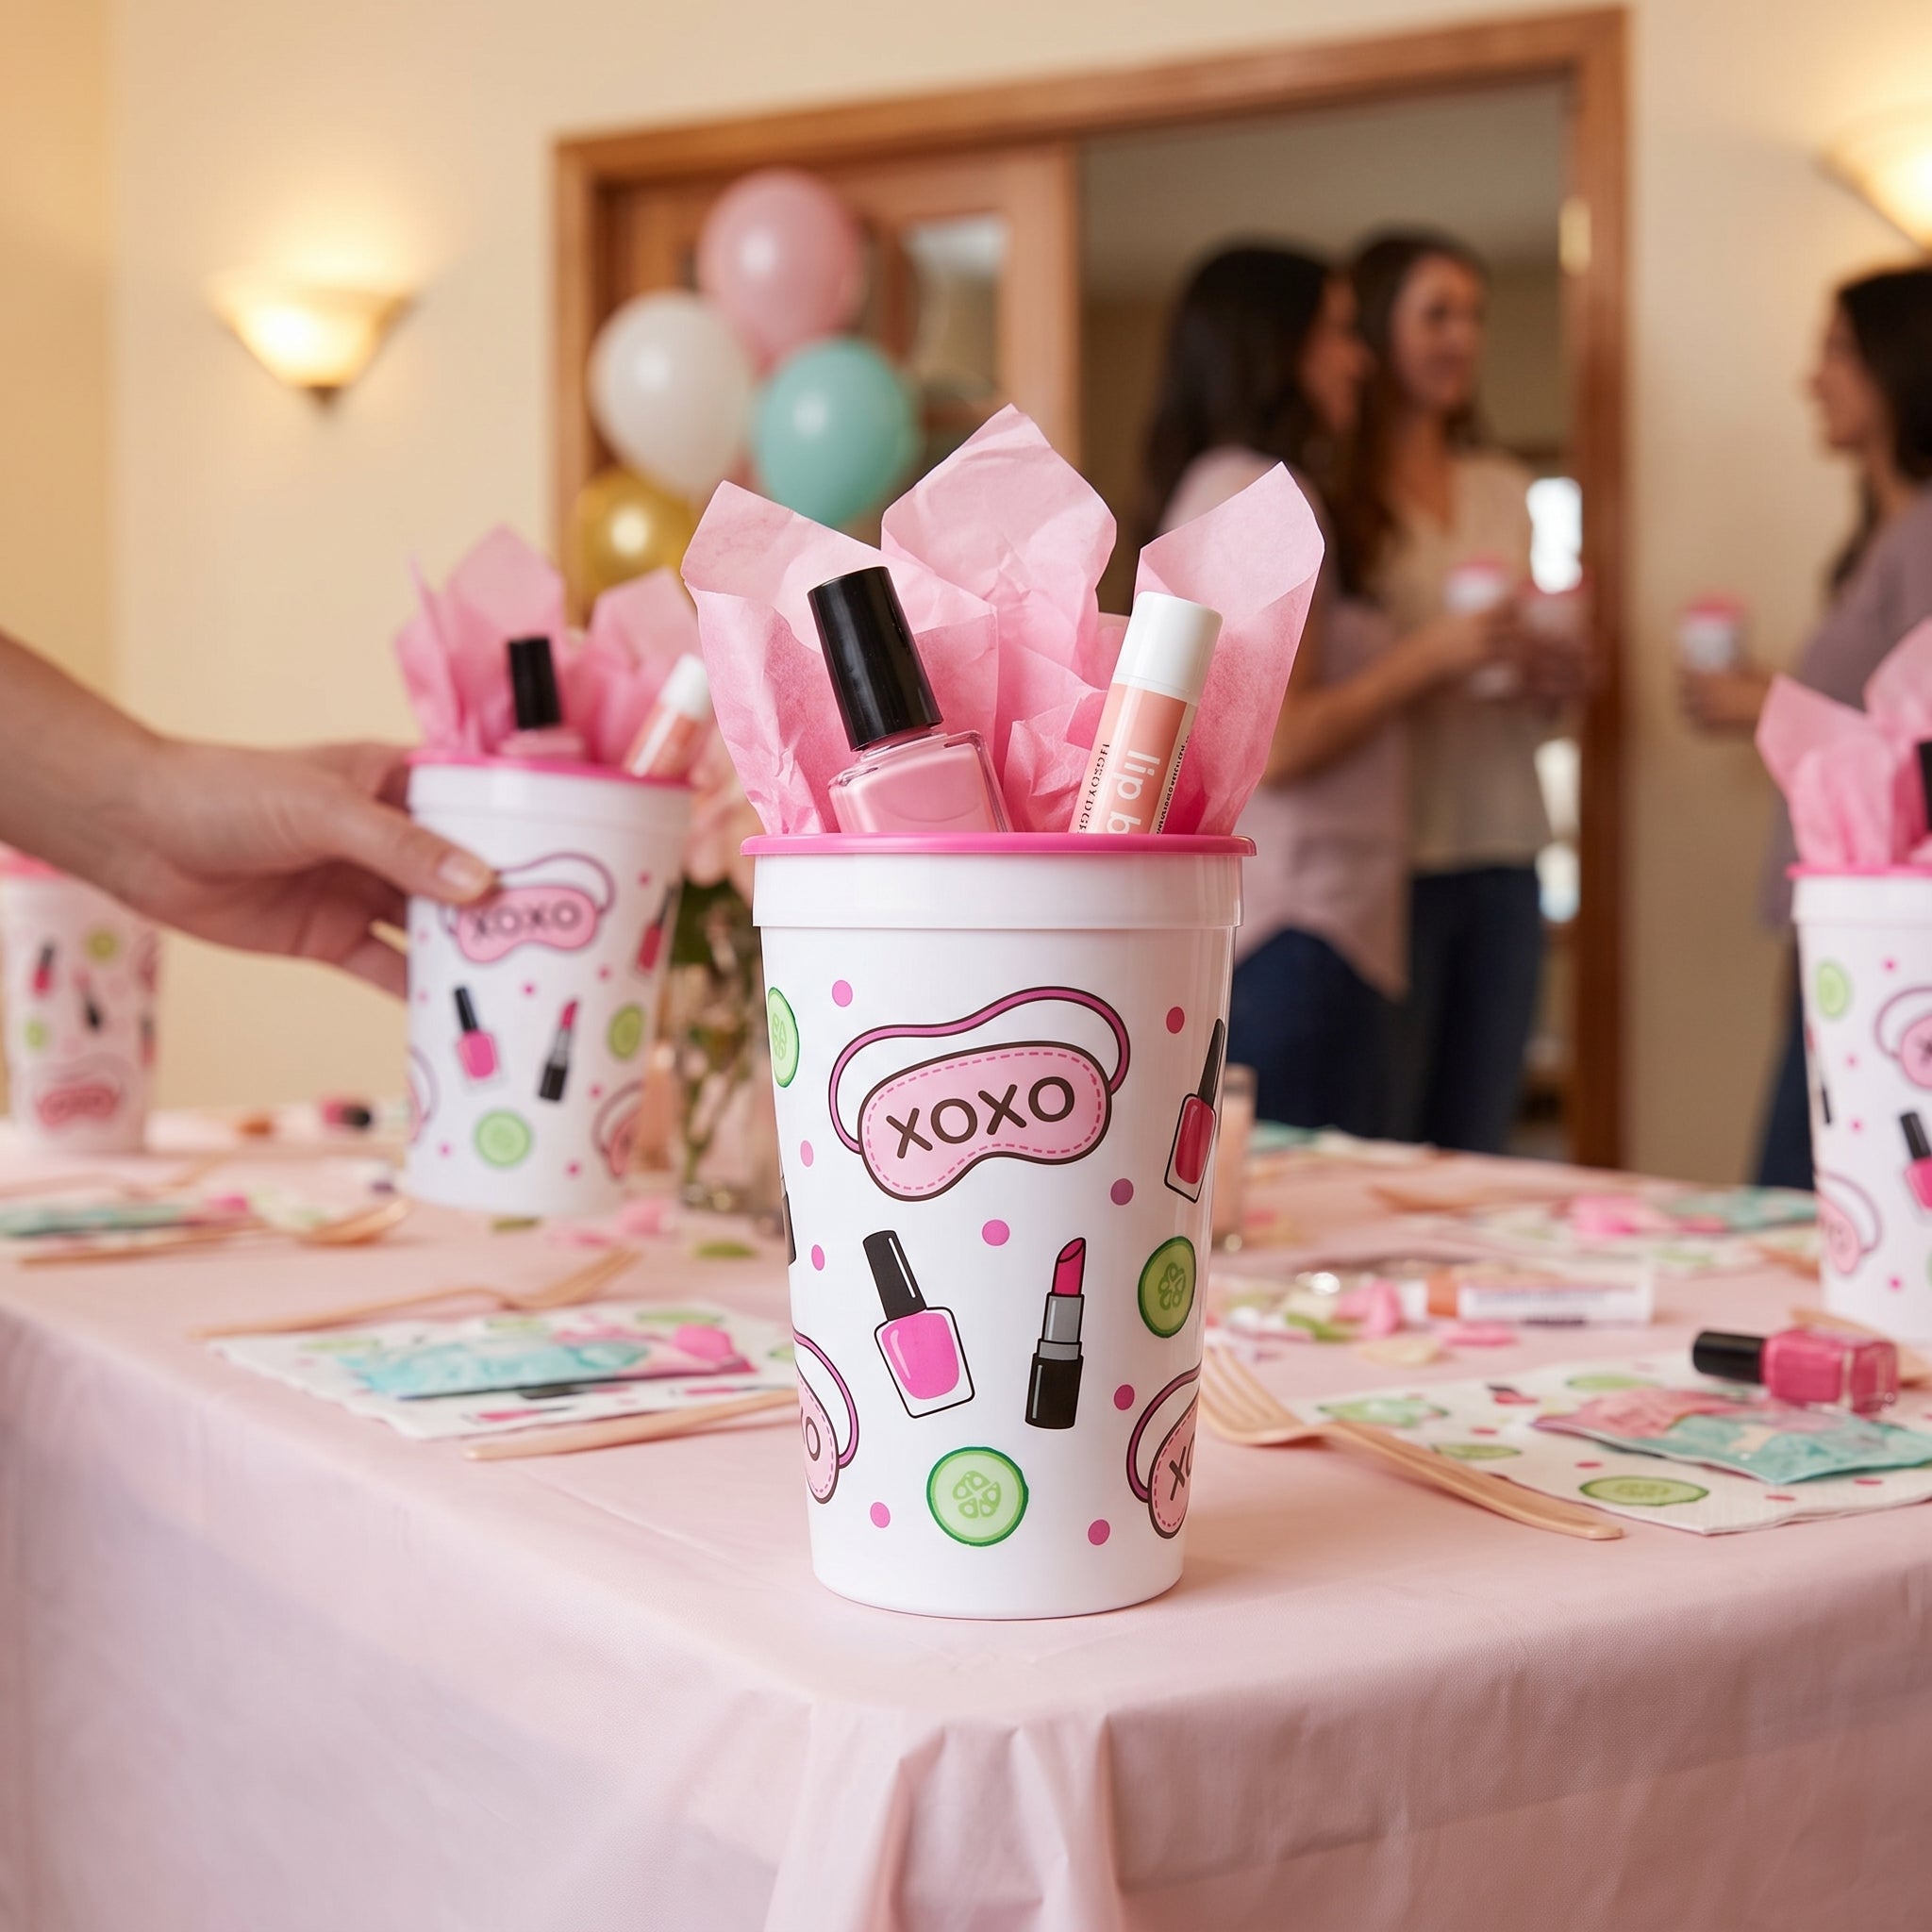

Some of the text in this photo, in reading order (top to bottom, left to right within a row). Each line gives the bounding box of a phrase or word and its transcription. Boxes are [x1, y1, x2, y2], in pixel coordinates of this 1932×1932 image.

[1113, 749, 1160, 801] lip
[472, 899, 582, 943] XOXO
[886, 1075, 1075, 1159] XOXO
